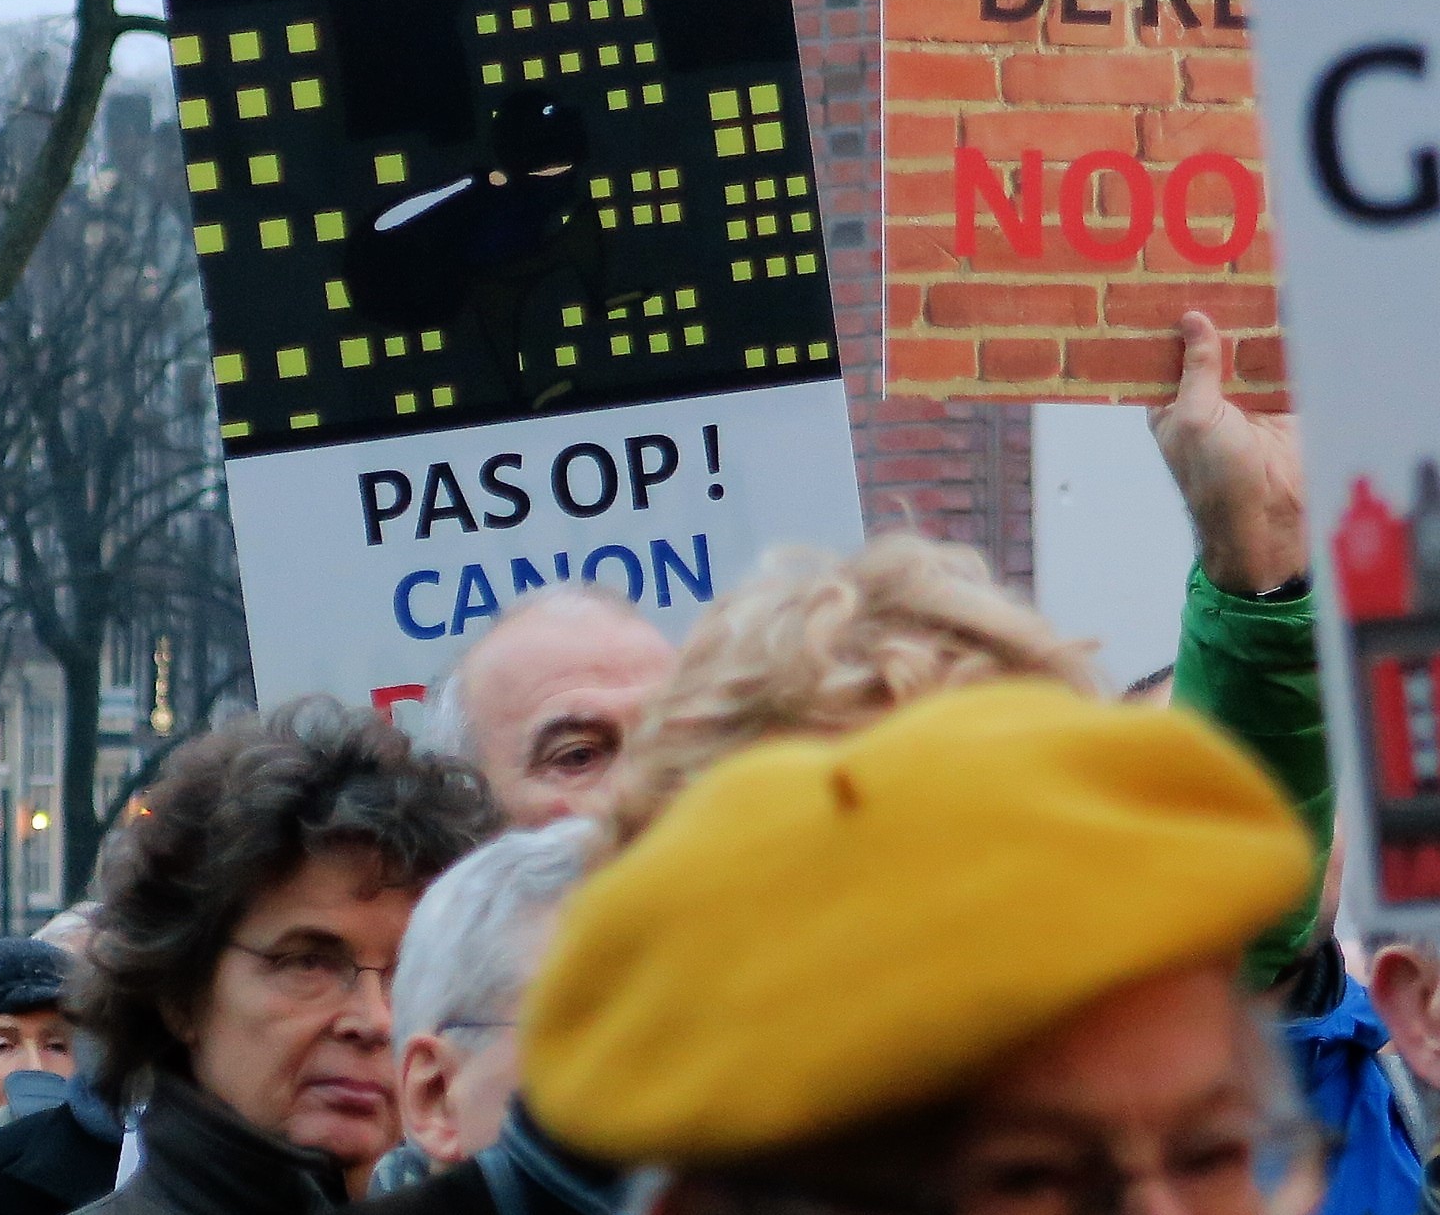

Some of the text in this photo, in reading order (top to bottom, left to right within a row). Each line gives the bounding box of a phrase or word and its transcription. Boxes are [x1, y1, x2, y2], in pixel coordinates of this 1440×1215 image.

[954, 146, 1261, 266] NOO
[358, 452, 531, 546] PAS
[550, 432, 679, 519] OP
